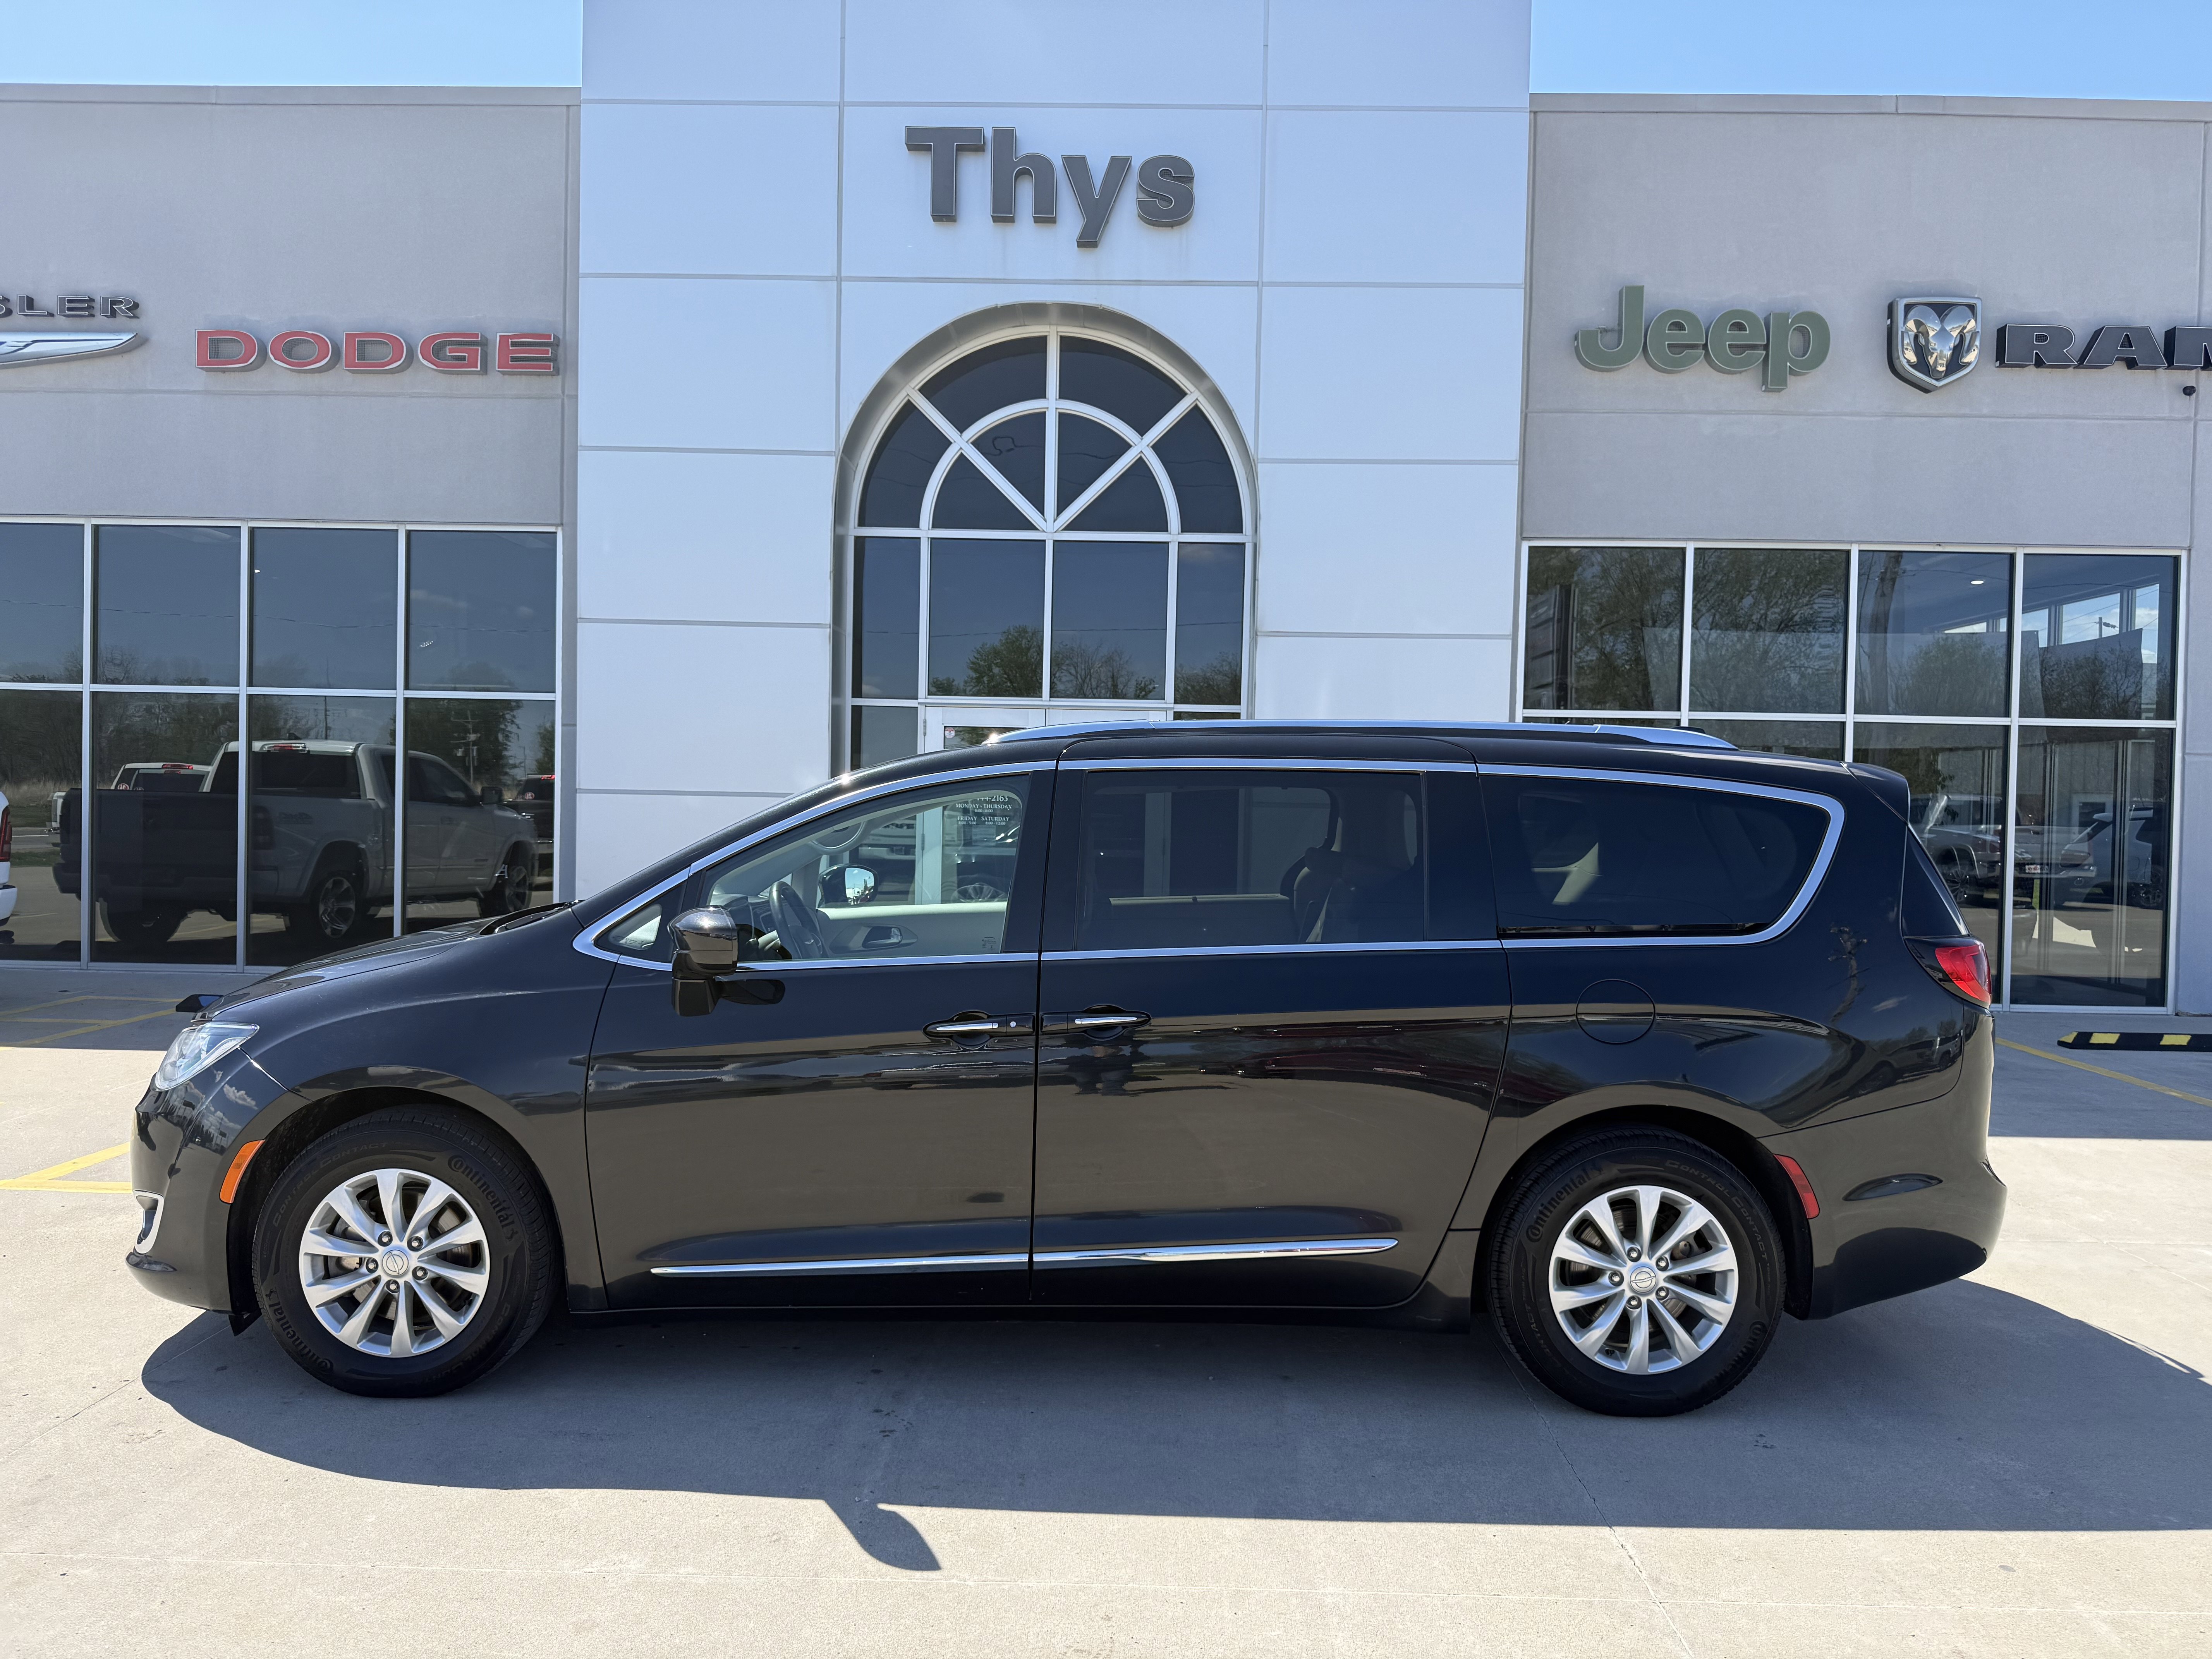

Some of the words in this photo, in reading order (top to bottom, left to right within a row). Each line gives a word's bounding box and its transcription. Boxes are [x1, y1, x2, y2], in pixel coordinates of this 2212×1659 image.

[905, 126, 1195, 248] Thys
[195, 329, 558, 374] DODGE
[1575, 285, 1831, 392] Jeep
[448, 1154, 516, 1231] Continental
[1525, 1170, 1591, 1243] Continental
